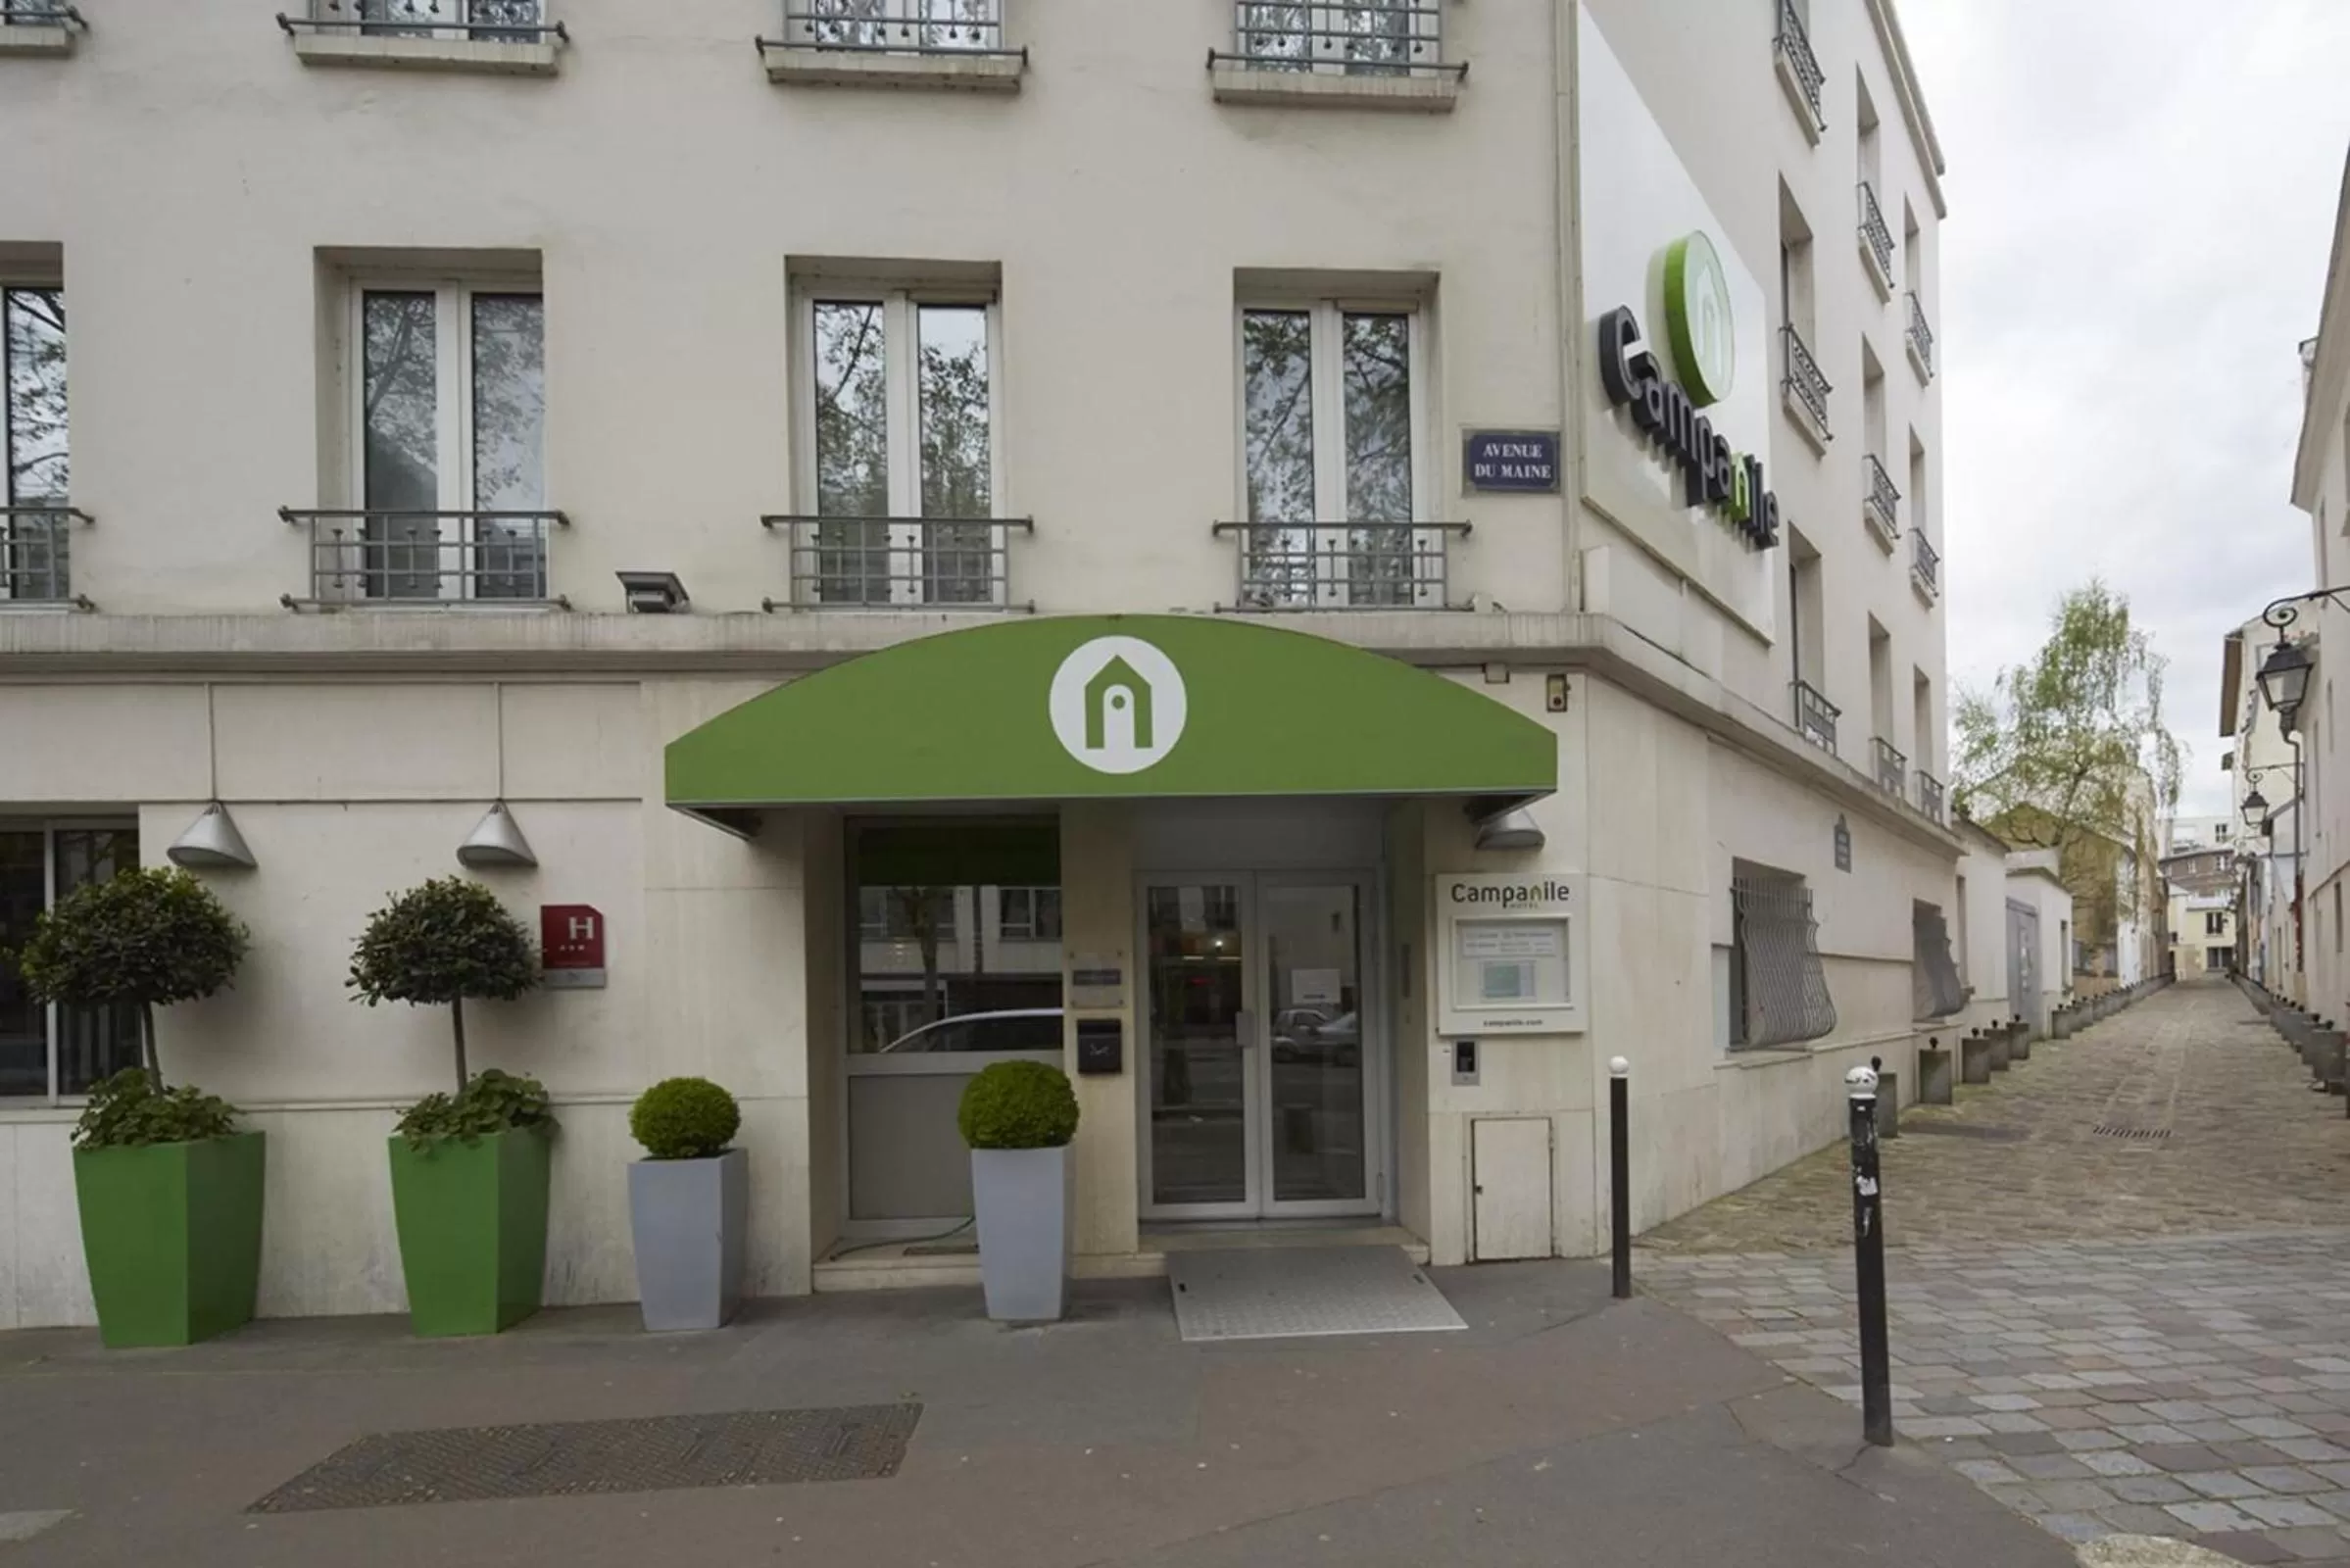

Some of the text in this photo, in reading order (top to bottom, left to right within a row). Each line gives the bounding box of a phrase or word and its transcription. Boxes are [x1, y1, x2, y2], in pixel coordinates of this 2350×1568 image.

[1598, 304, 1779, 551] Campanile
[1483, 443, 1542, 459] AVENUE
[1474, 463, 1551, 479] DU MAINE
[1450, 882, 1570, 908] Campanile
[569, 916, 594, 940] H
